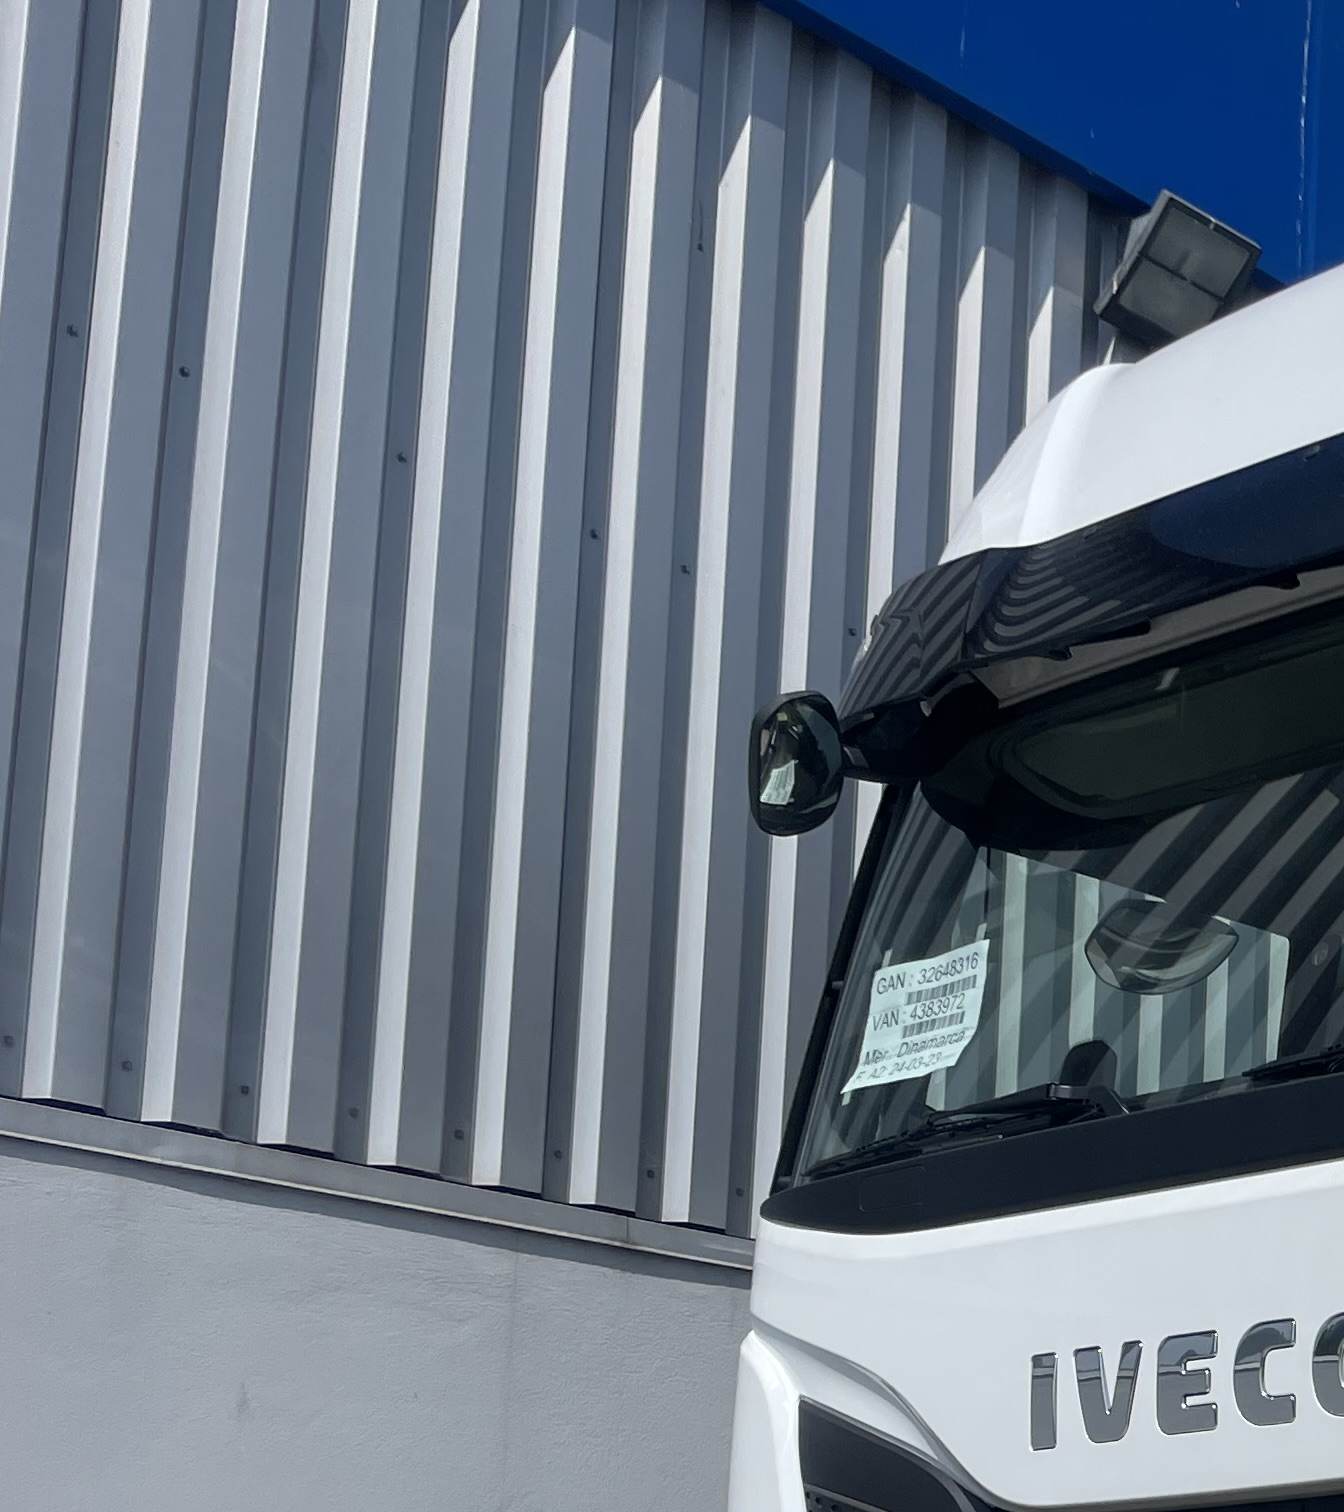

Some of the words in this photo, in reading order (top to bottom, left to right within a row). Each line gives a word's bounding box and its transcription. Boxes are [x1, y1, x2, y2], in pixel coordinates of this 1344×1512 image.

[876, 972, 906, 995] GAN
[917, 951, 979, 985] 32648316
[872, 1009, 900, 1032] VAN
[909, 992, 965, 1020] 4383972
[897, 1030, 965, 1058] Dinamarca
